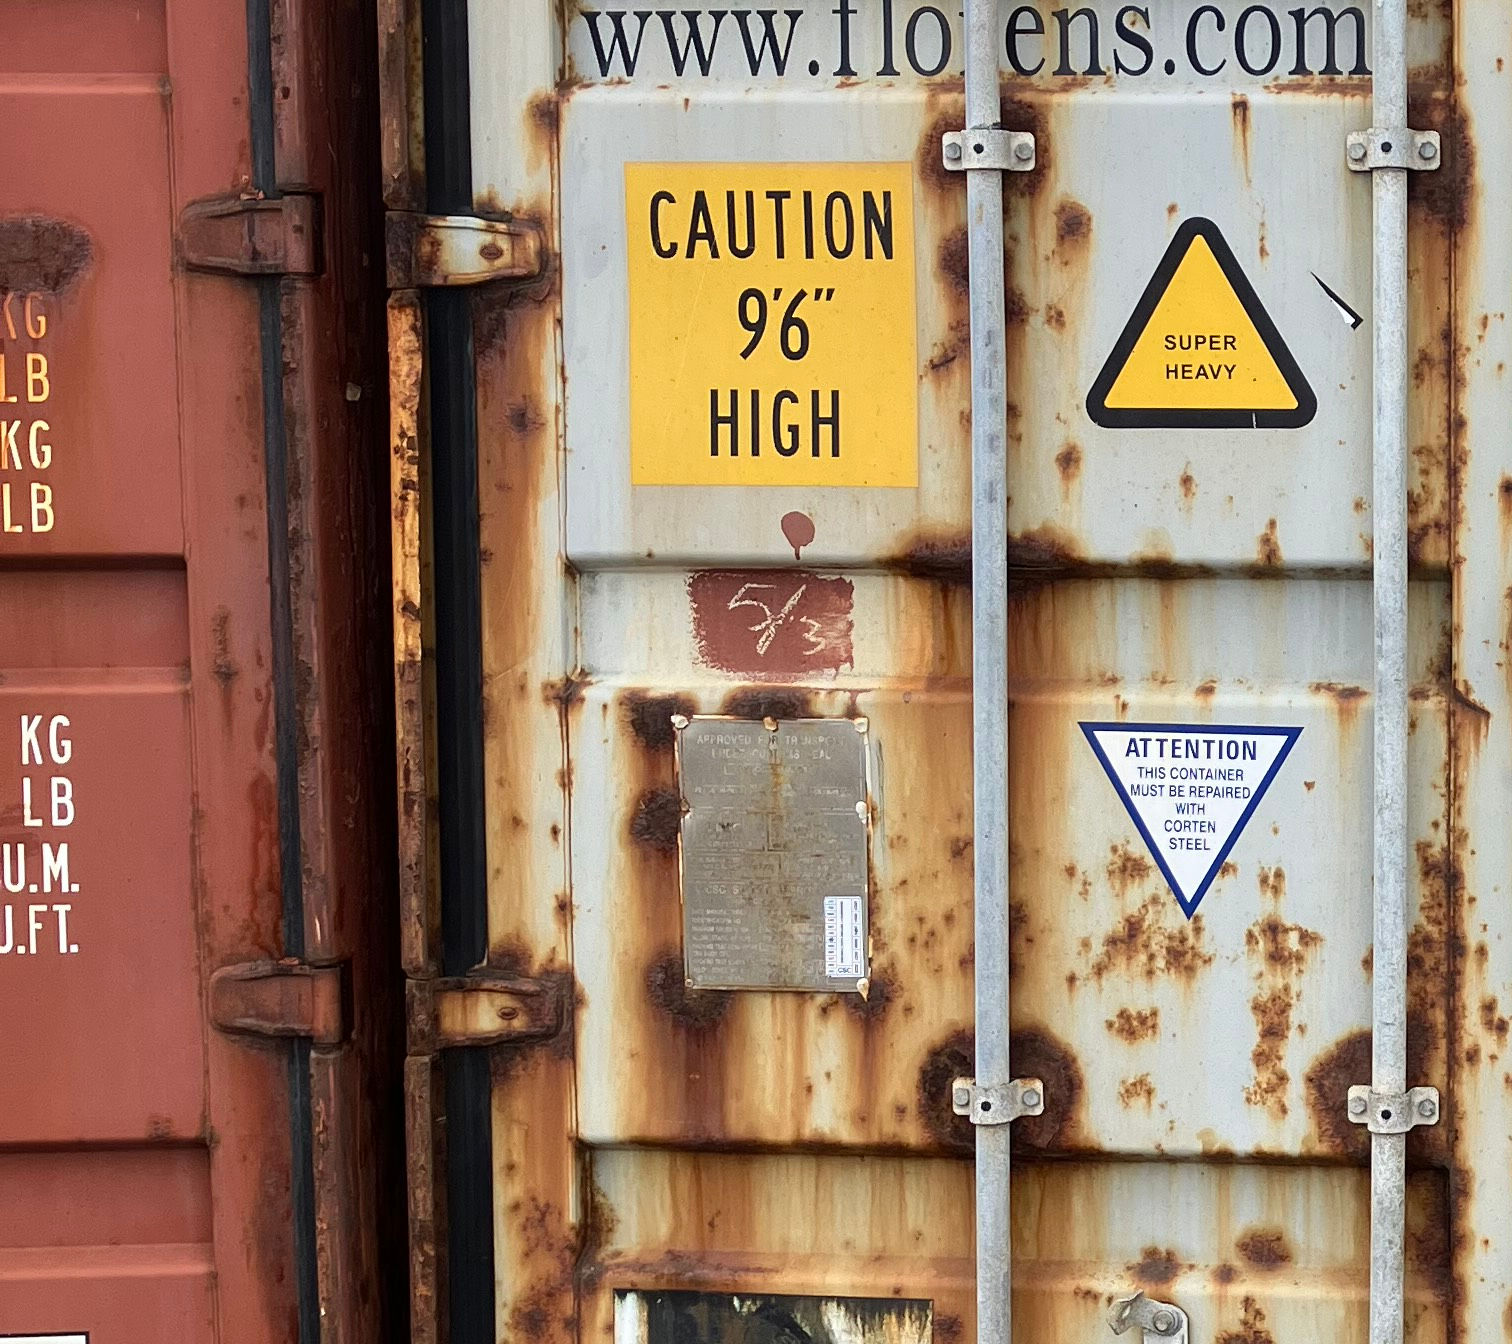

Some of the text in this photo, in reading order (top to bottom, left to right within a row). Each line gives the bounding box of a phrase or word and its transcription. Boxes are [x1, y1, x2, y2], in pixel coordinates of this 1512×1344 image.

[649, 190, 895, 261] CAUTION
[1164, 334, 1238, 352] SUPER
[0, 353, 50, 403] LB
[1165, 364, 1237, 381] HEAVY
[709, 388, 842, 459] HIGH
[0, 420, 52, 471] KG
[2, 482, 55, 533] LB
[20, 715, 72, 766] KG
[1125, 738, 1257, 760] ATTENTION
[1137, 767, 1244, 781] THIS CONTAINER
[23, 777, 75, 827] LB
[1130, 784, 1250, 799] MUST BE REPAIRED
[1175, 803, 1205, 815] WITH
[1164, 820, 1216, 833] CORTEN
[1169, 838, 1211, 850] STEEL
